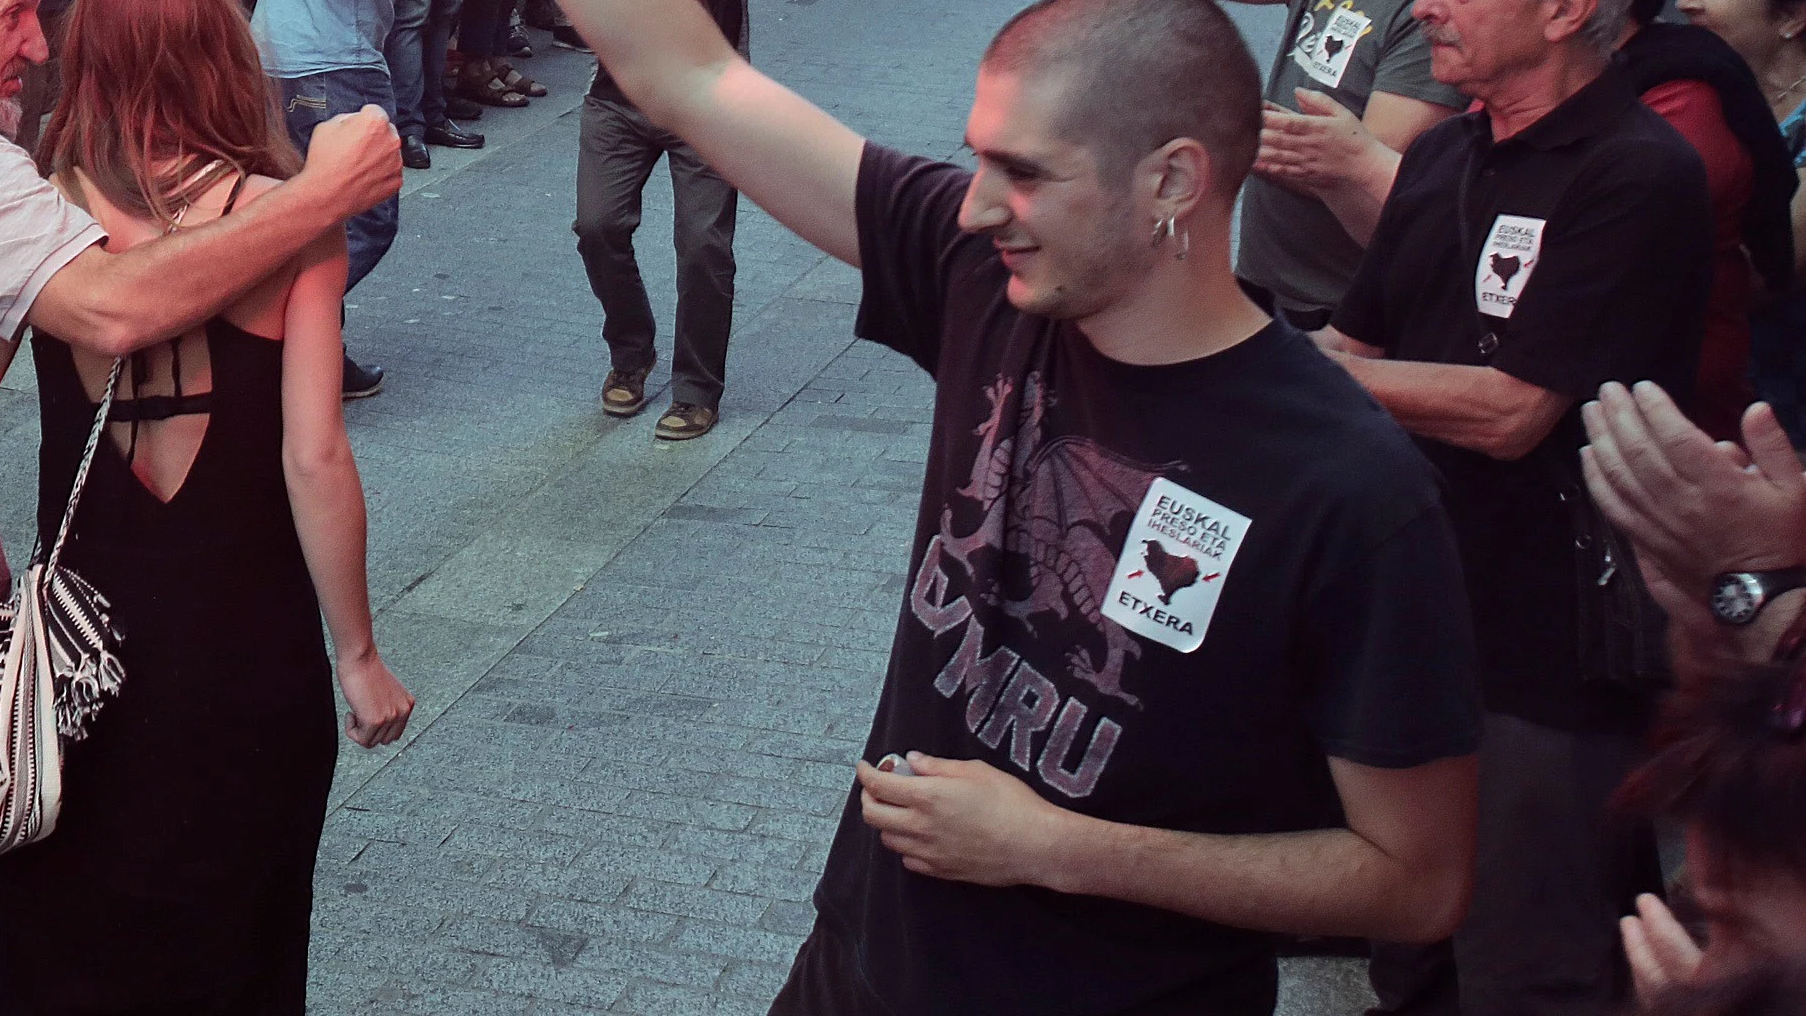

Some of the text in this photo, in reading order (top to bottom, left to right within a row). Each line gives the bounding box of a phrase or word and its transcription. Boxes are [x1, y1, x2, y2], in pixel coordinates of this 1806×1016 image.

[1147, 518, 1224, 562] IHESLARIAK
[1151, 508, 1227, 552] PRESO ETA
[1156, 495, 1232, 541] EUSKAL
[1118, 590, 1194, 636] ETXERA
